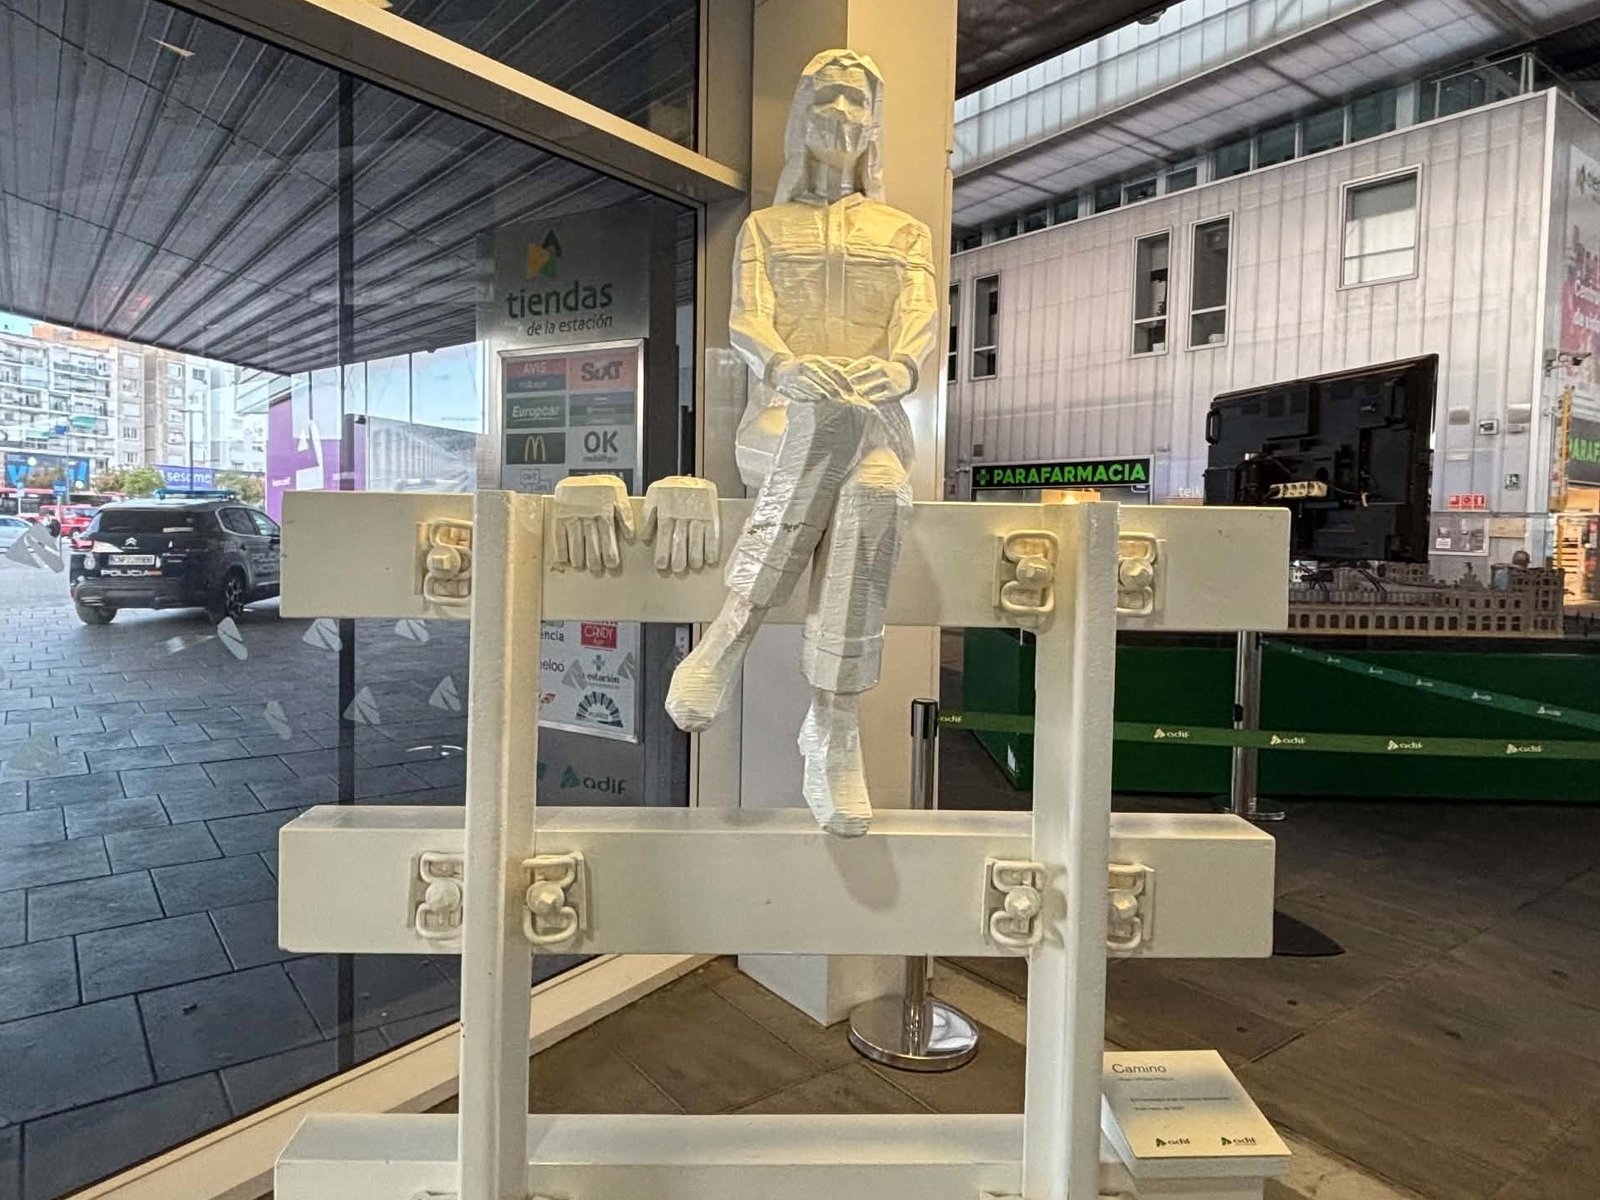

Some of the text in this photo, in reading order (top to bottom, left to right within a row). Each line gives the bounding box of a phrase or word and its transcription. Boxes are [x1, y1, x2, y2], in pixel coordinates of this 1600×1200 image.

[506, 281, 613, 319] tiendas
[527, 313, 613, 336] de la estación
[522, 361, 548, 375] AVIS
[512, 405, 559, 419] Europcar
[584, 431, 618, 453] OK
[994, 463, 1145, 485] PARAFARMACIA
[583, 776, 627, 794] adif
[1112, 1063, 1167, 1074] Camino
